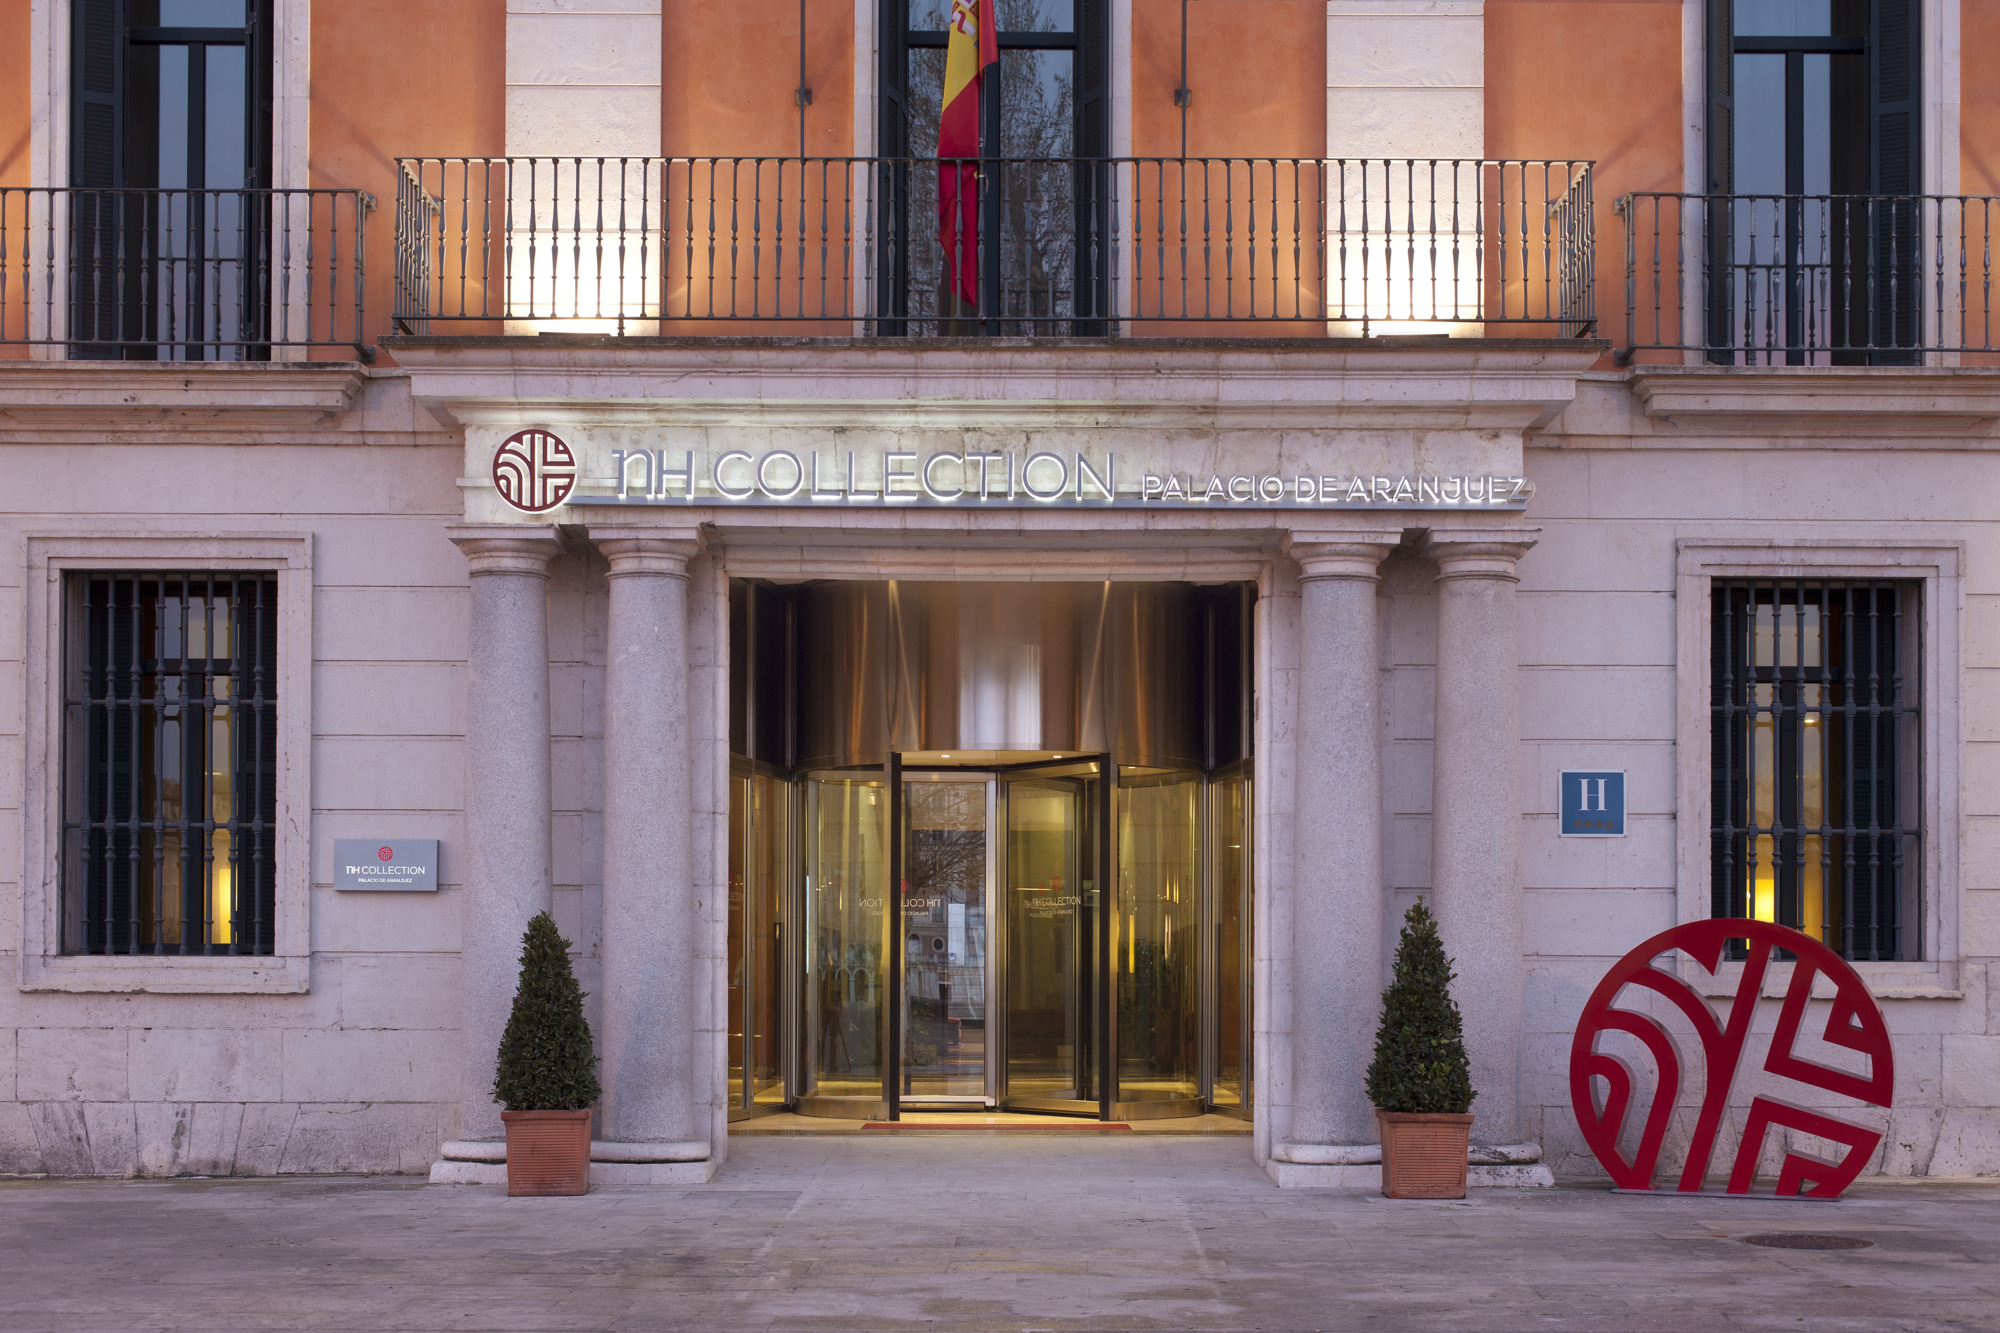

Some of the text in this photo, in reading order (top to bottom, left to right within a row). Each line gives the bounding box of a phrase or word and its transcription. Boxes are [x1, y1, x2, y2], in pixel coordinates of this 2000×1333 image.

[713, 450, 1115, 500] COLLECTION
[1143, 474, 1286, 501] PALACIO
[1295, 475, 1339, 501] DE
[1346, 475, 1527, 502] ARANJUEZ
[1578, 779, 1608, 811] H
[361, 865, 426, 875] COLLECTION
